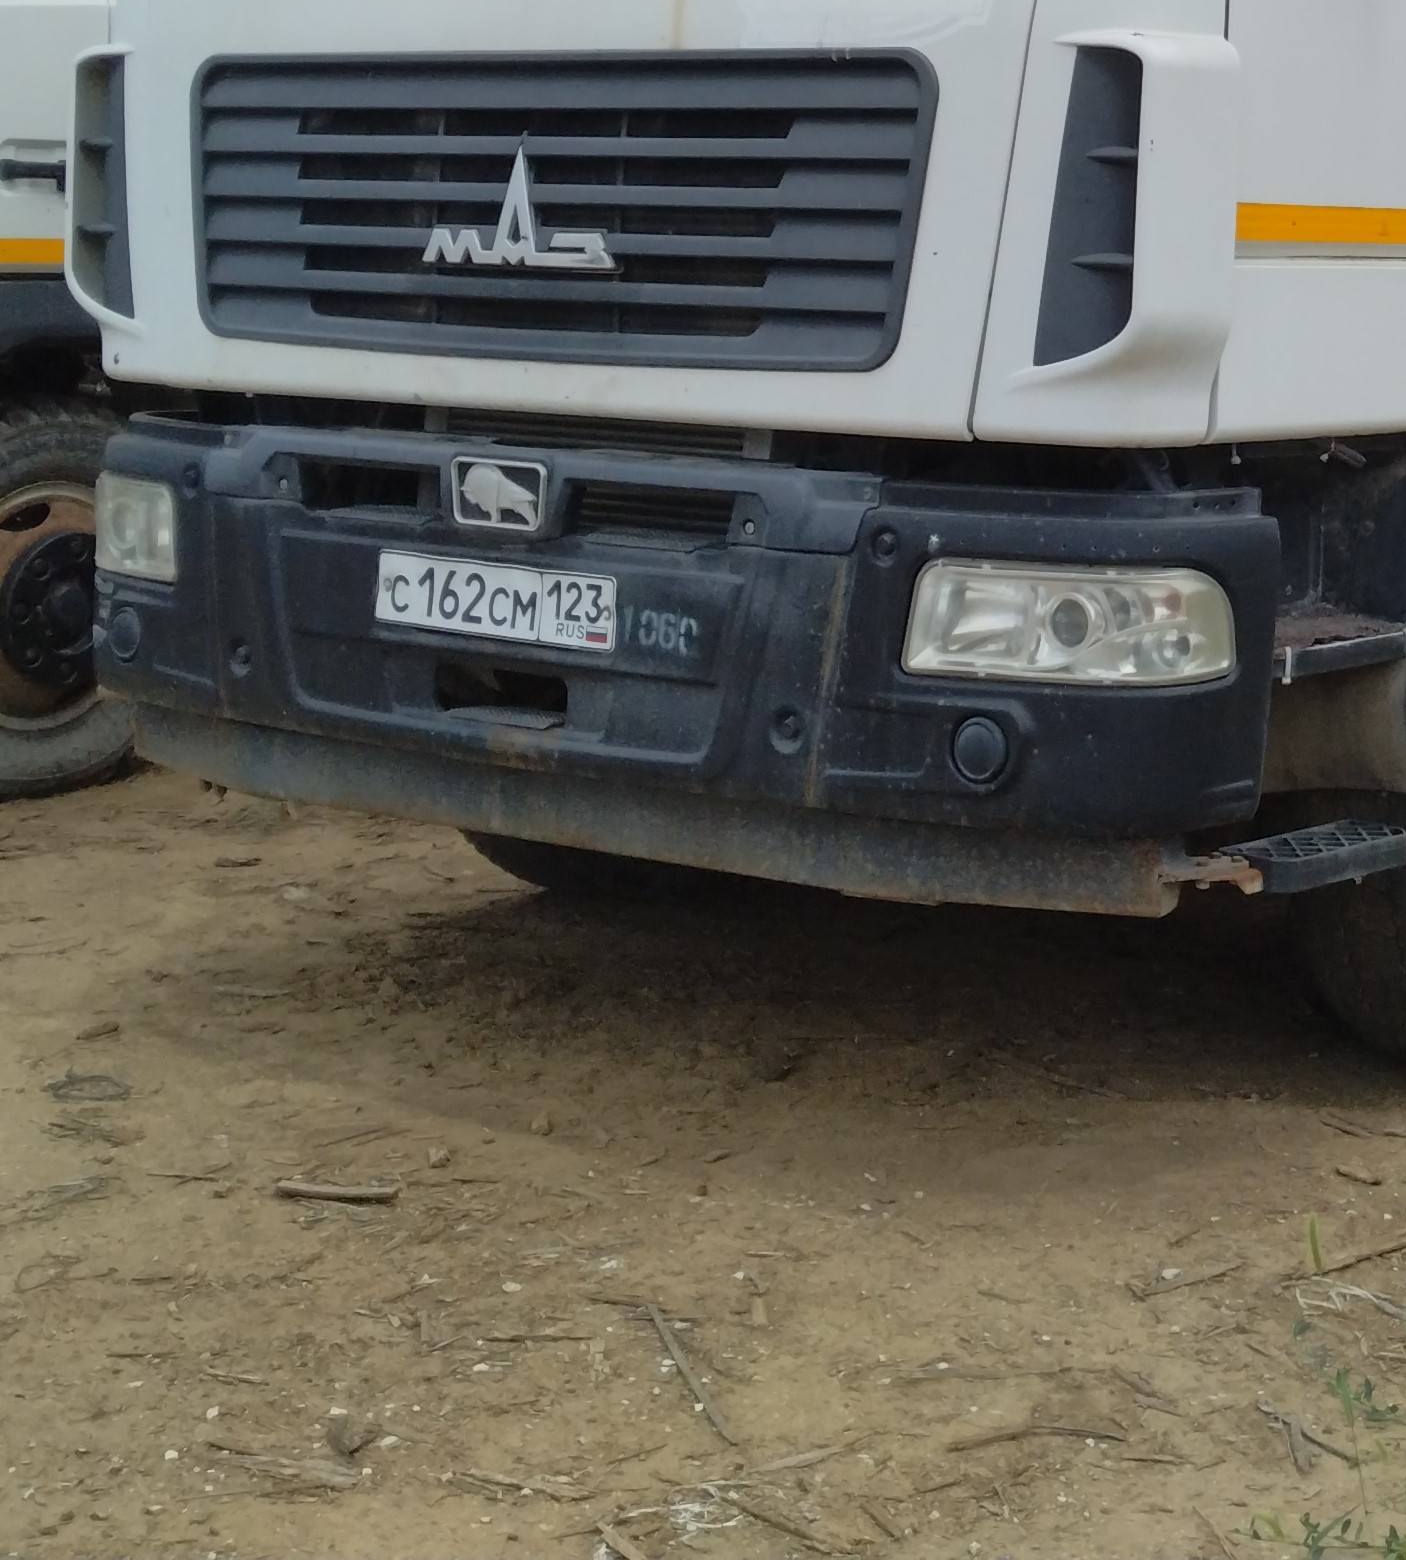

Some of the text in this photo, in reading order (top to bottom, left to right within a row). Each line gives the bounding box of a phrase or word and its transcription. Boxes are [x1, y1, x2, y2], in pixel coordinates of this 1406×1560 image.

[422, 143, 617, 269] МАЗ
[547, 578, 603, 625] 123
[555, 623, 585, 640] RUS
